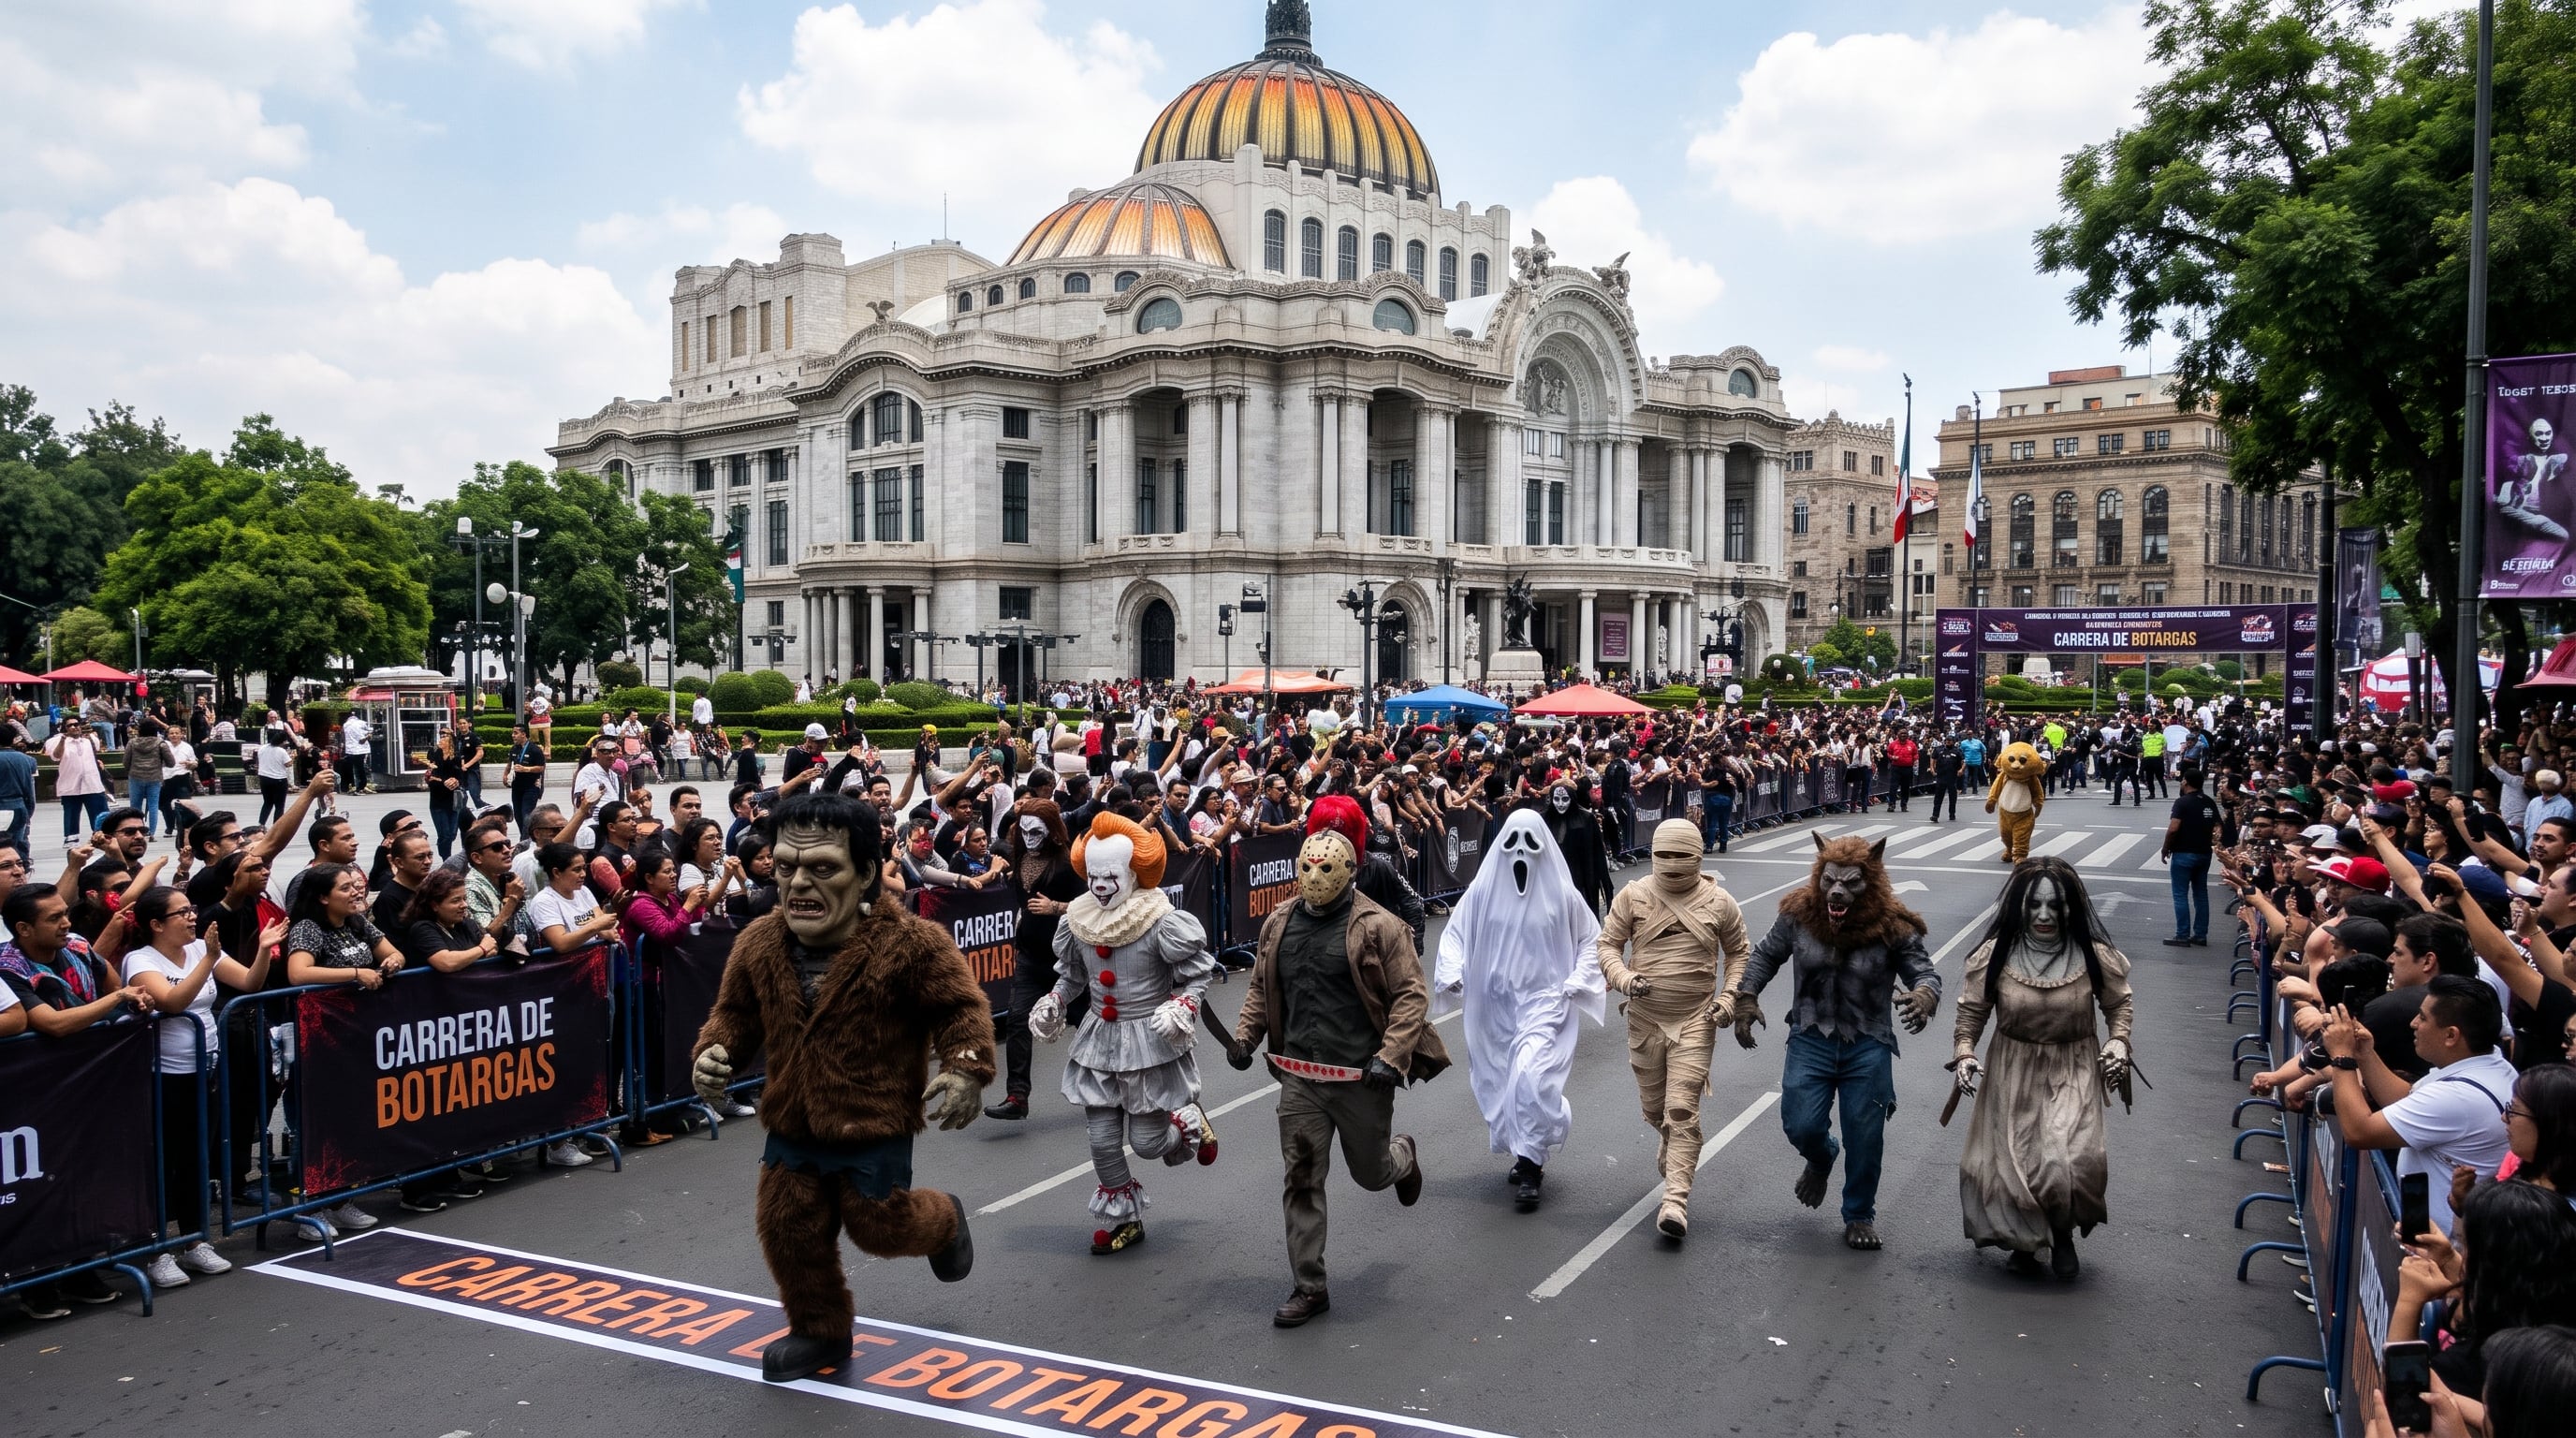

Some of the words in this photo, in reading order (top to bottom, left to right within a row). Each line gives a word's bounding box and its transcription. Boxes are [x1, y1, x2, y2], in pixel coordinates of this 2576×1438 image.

[2054, 632, 2110, 647] CARRERA
[2112, 632, 2129, 647] DE
[2131, 631, 2197, 647] BOTARGAS
[1250, 858, 1294, 887] CARRERA
[954, 910, 1014, 949] CARRER
[375, 1005, 514, 1070] CARRERA
[520, 996, 554, 1042] DE
[376, 1042, 556, 1129] BOTARGAS
[396, 1256, 754, 1345] CARRERA
